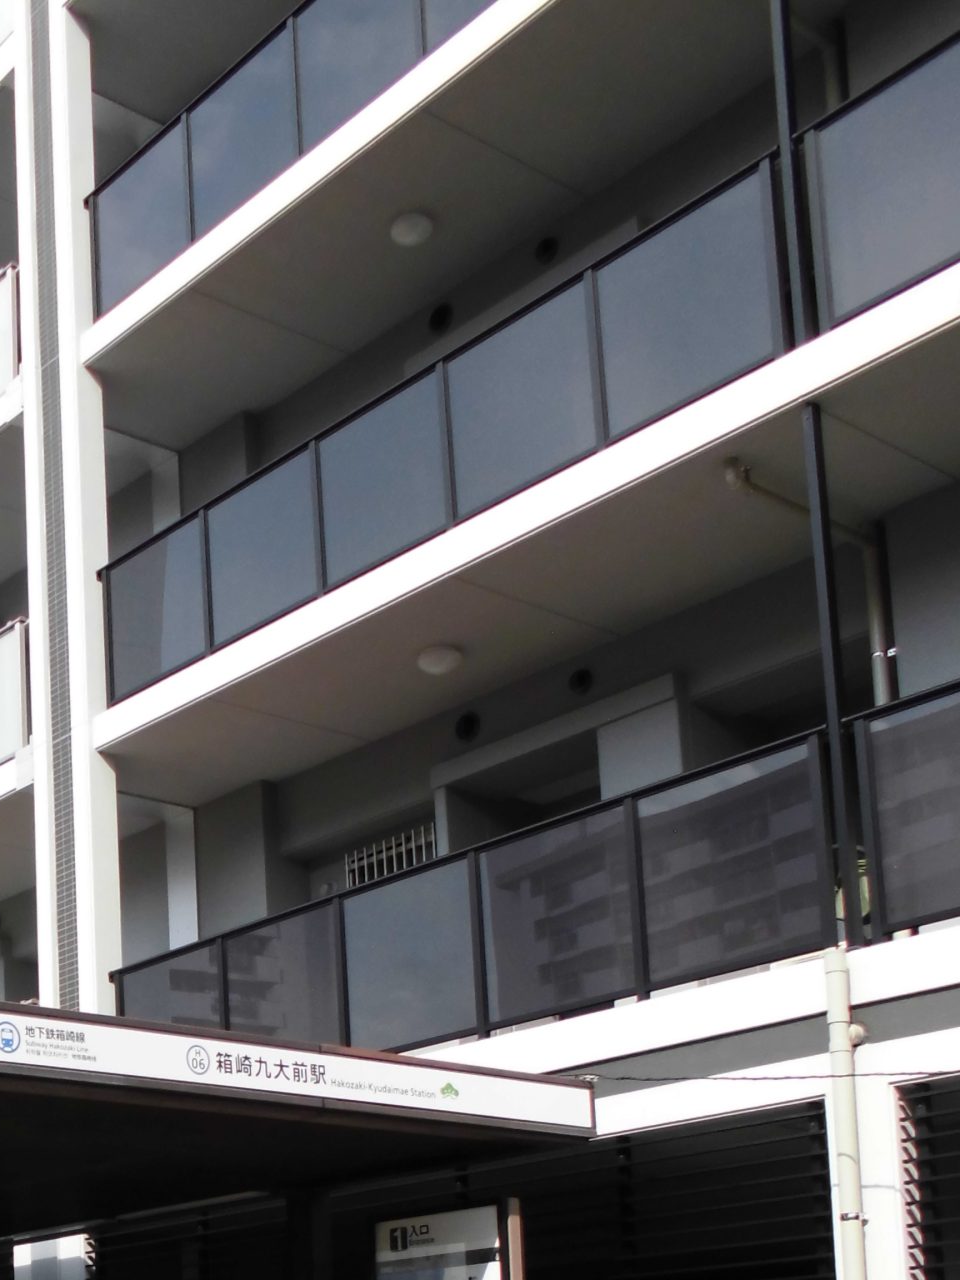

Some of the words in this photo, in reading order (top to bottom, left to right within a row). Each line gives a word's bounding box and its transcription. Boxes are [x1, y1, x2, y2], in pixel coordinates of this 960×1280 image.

[25, 1025, 85, 1043] 地下鉄箱崎線
[191, 1058, 205, 1070] 06
[216, 1051, 327, 1085] 箱崎九大前駅
[410, 1087, 437, 1099] Station
[408, 1224, 429, 1238] 入口
